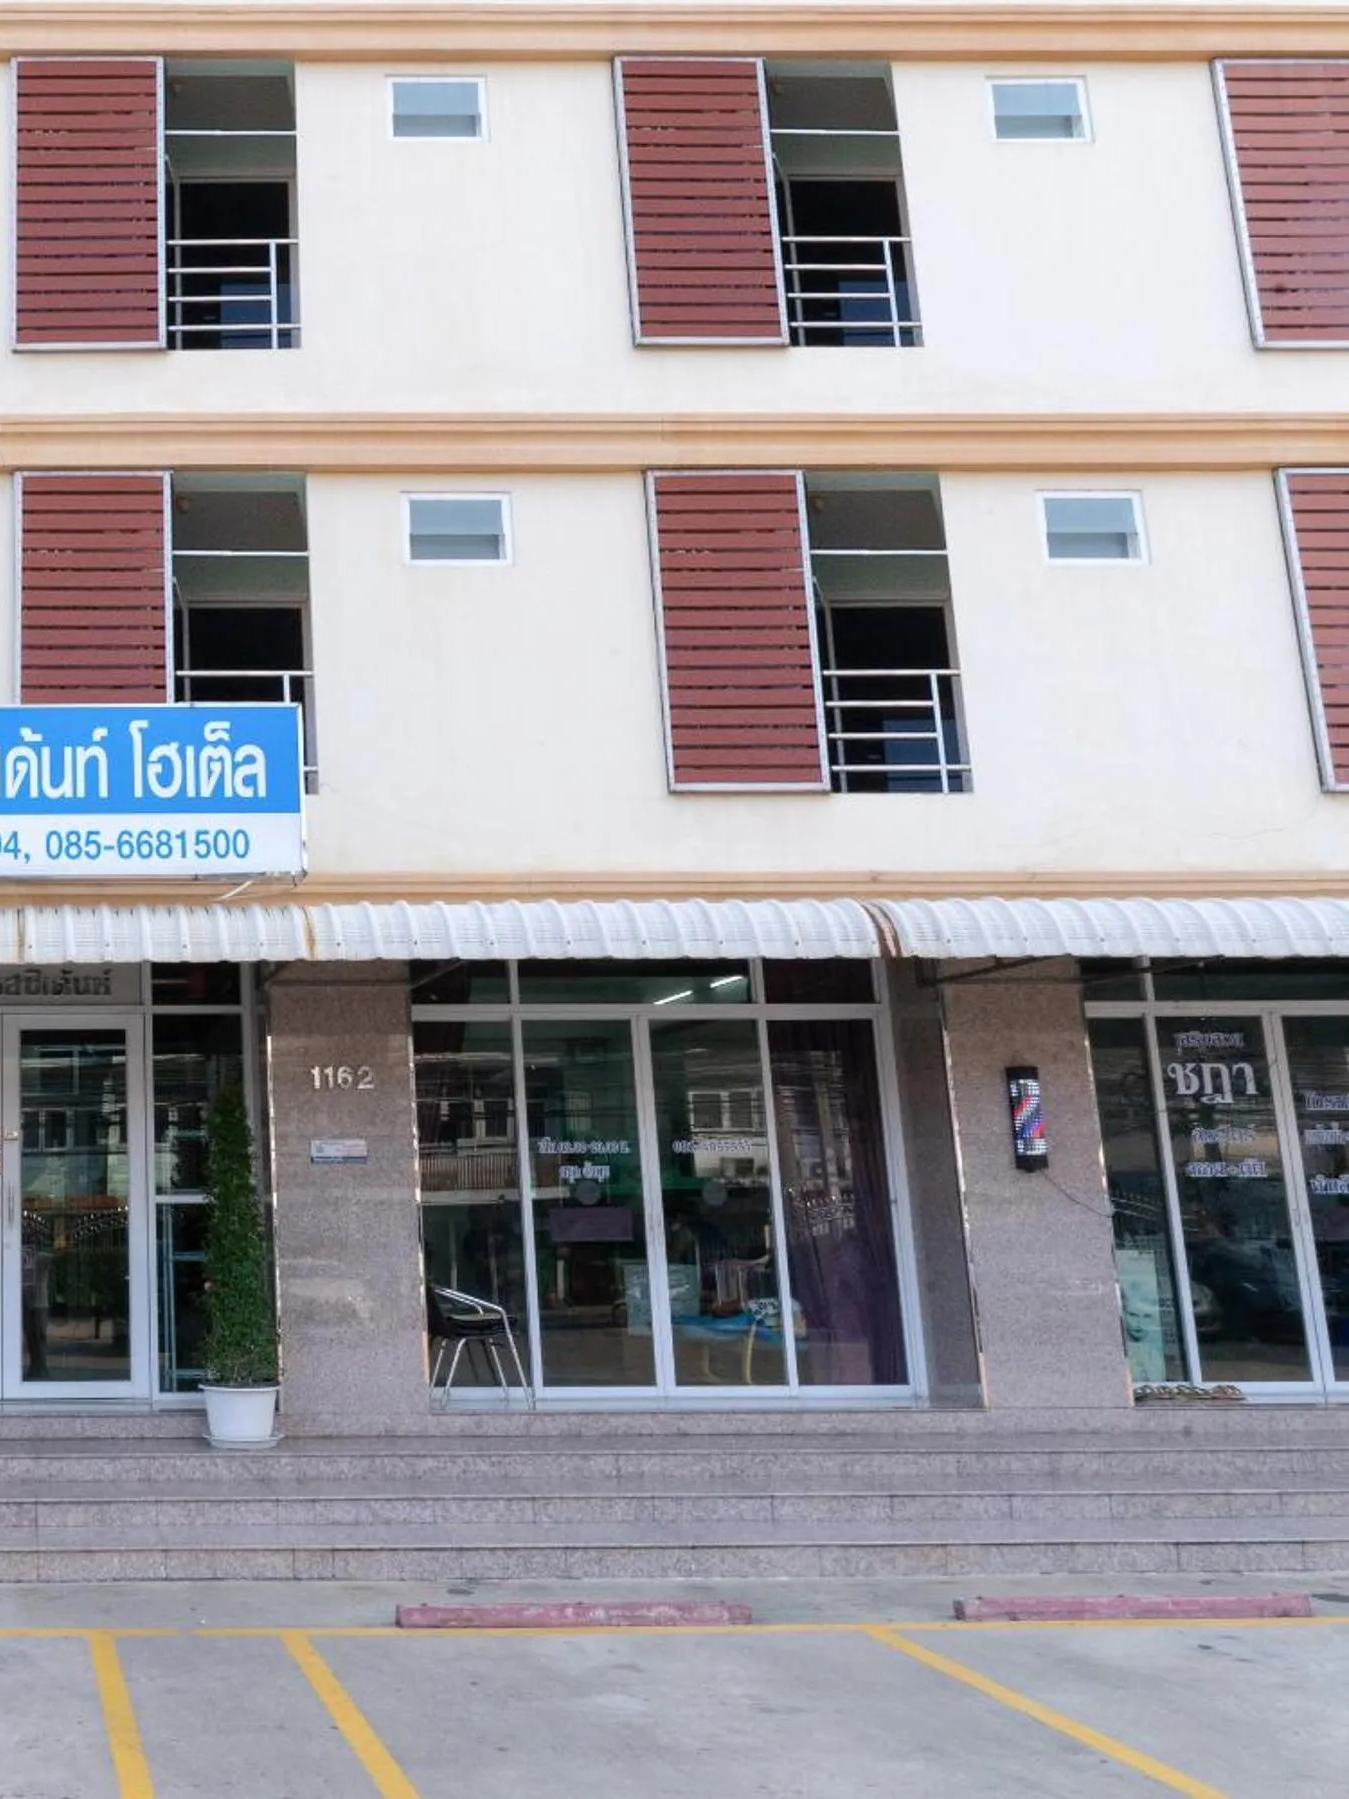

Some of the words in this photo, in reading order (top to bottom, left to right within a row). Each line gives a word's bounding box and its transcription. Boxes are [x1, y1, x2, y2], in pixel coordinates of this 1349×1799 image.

[129, 719, 267, 800] โฮเต็ล
[45, 828, 251, 861] 085-6681500
[310, 1065, 375, 1090] 1162
